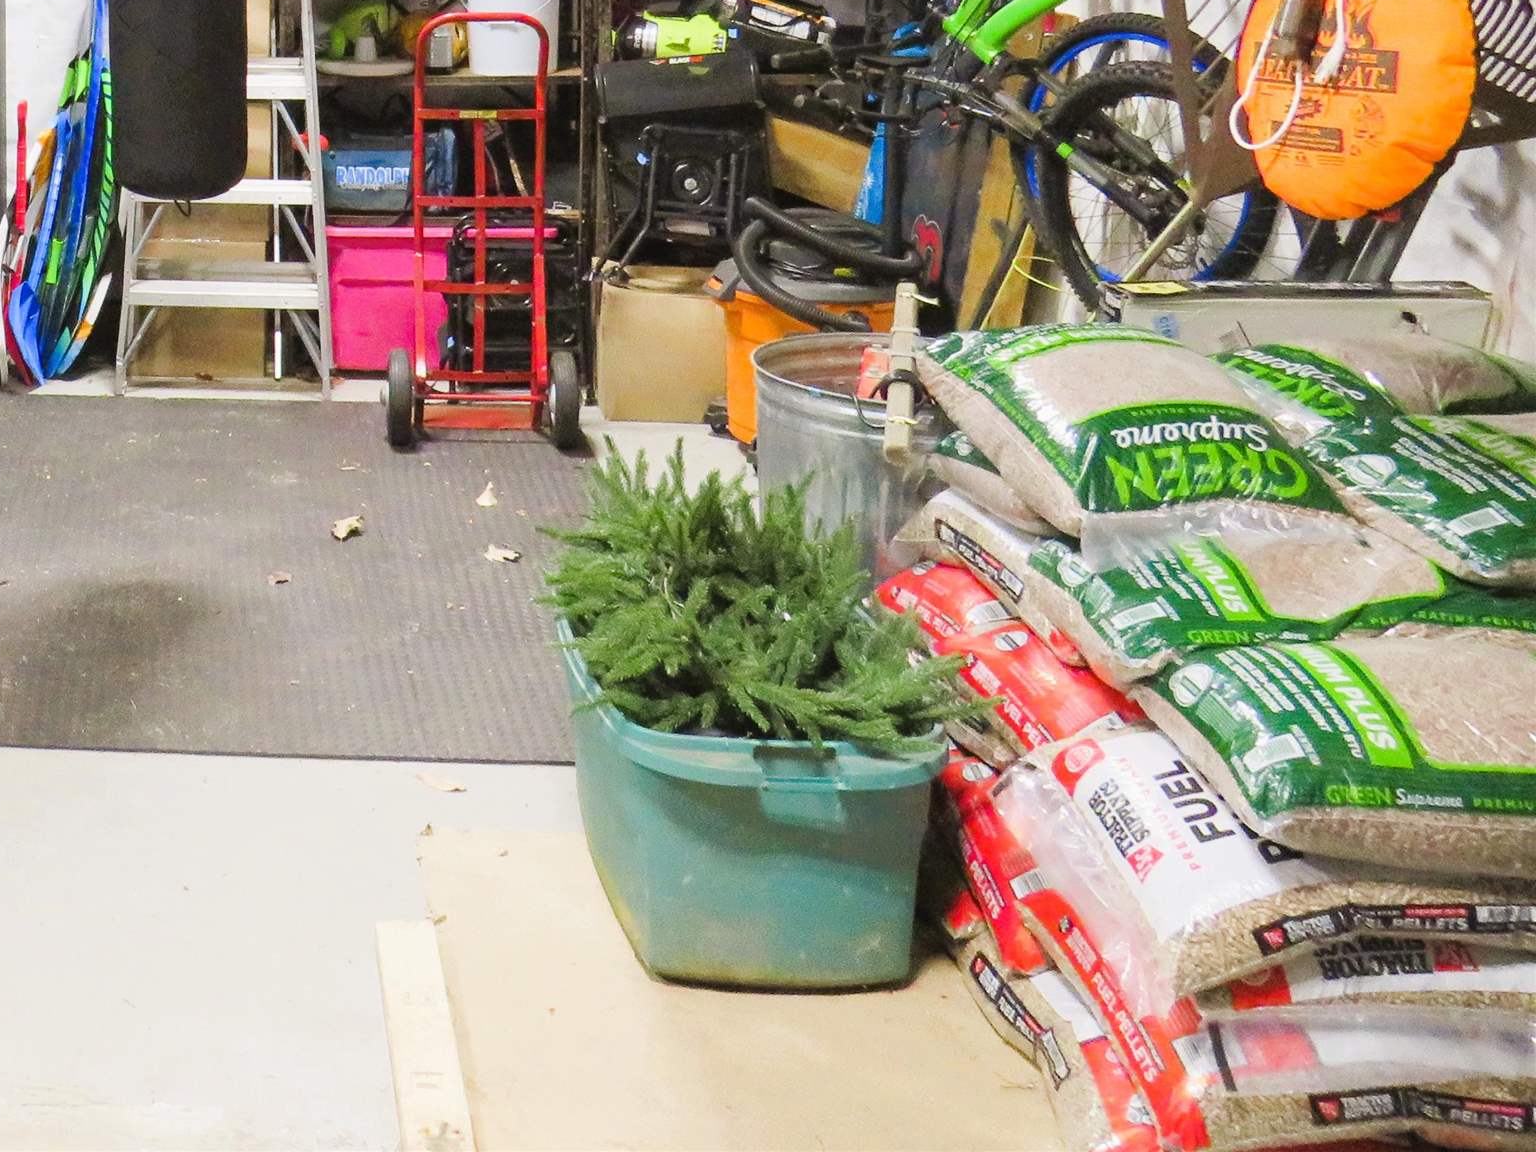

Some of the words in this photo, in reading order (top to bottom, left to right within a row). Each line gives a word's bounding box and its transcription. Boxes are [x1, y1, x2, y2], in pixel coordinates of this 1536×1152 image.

[1110, 415, 1269, 452] Supreme
[1105, 442, 1309, 507] GREEN
[1206, 564, 1251, 615] PLUS
[1186, 629, 1252, 646] GREEN
[1333, 685, 1399, 751] PLUS
[1106, 791, 1152, 844] SUPPLY
[1152, 758, 1238, 844] FUEL
[1325, 784, 1396, 806] GREEN
[1395, 787, 1465, 808] Supreme
[1088, 790, 1136, 859] TRACTOR
[969, 858, 1001, 921] PELLETS
[1391, 917, 1470, 932] PELLETS
[1317, 951, 1434, 981] TRACTOR
[1091, 972, 1116, 1012] FUEL
[1115, 1010, 1158, 1083] PELLETS
[1449, 1107, 1525, 1132] PELLETS
